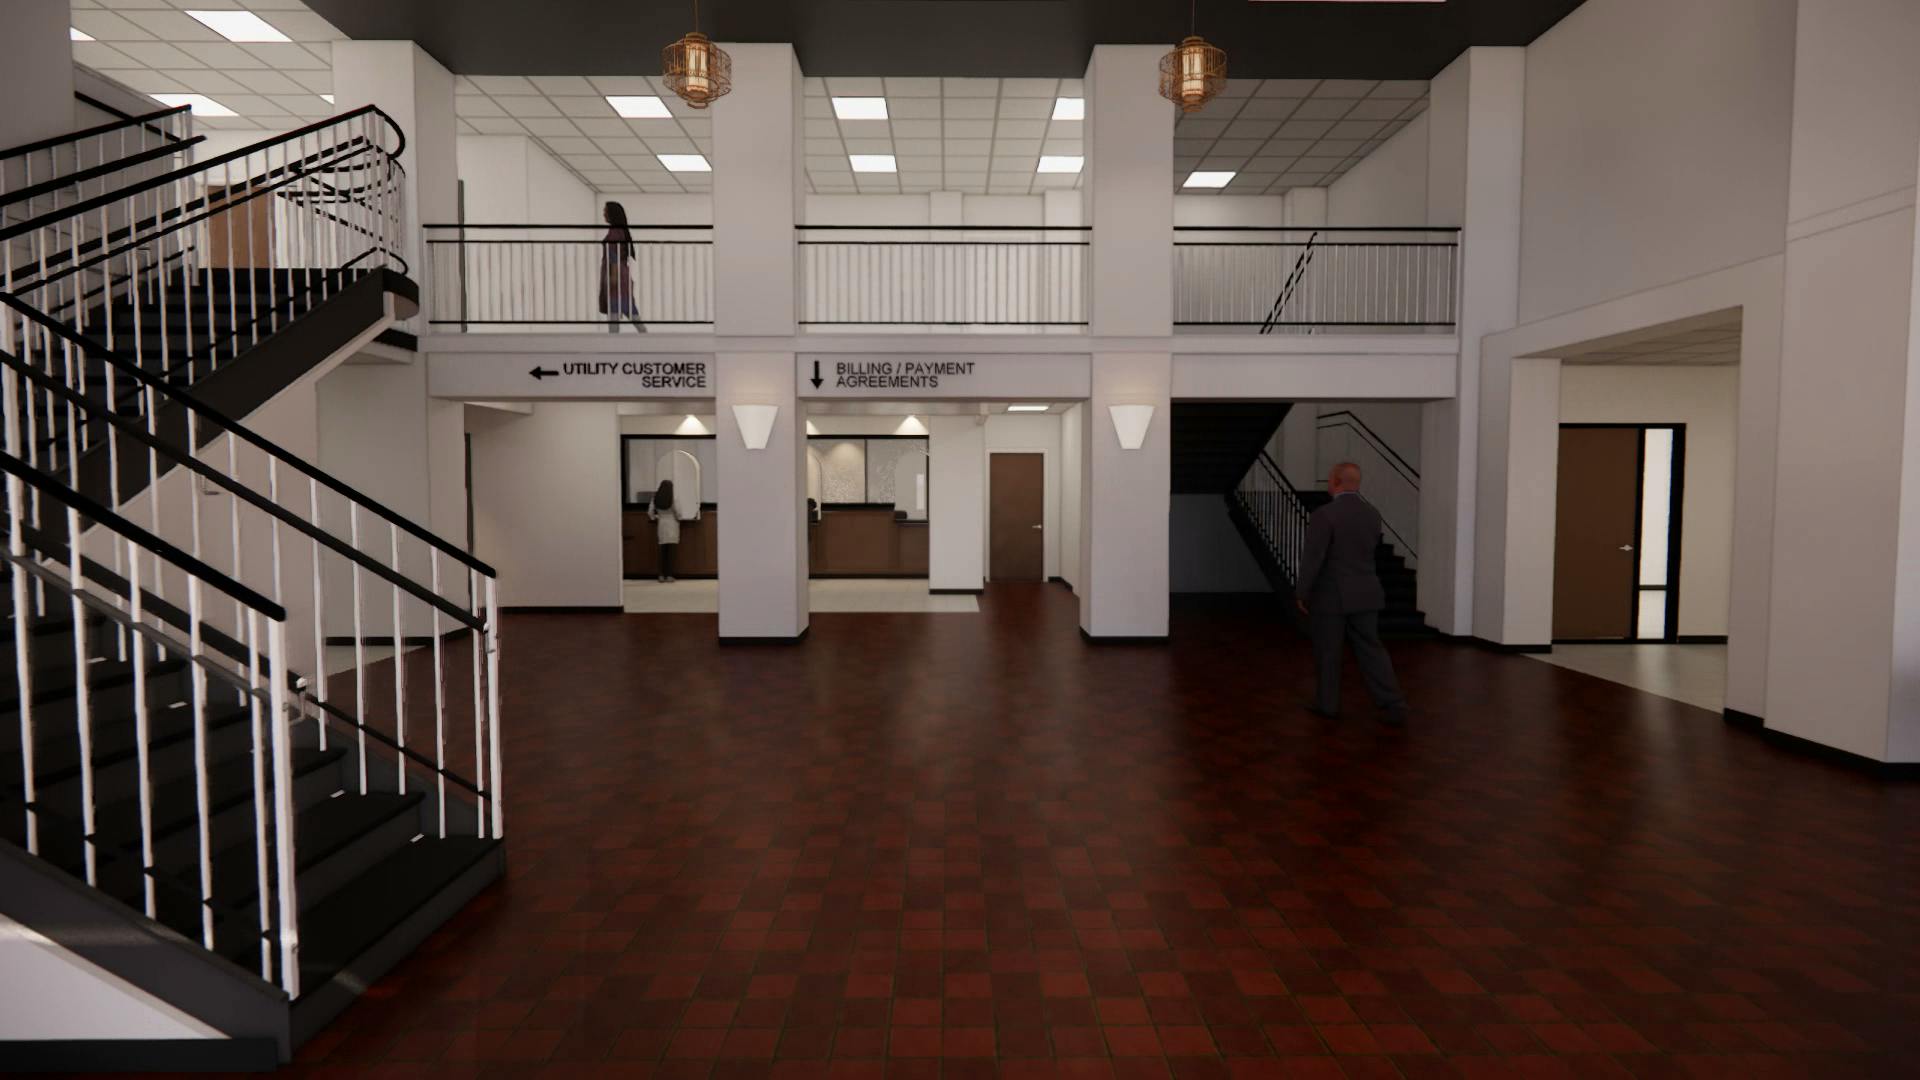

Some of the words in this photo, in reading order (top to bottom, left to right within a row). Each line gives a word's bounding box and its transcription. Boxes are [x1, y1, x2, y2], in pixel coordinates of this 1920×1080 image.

[563, 362, 618, 375] UTILITY
[622, 362, 706, 375] CUSTOMER
[836, 362, 892, 375] BILLING
[905, 362, 975, 375] PAYMENT
[642, 375, 706, 388] SERVICE
[836, 375, 938, 388] AGREEMENTS
